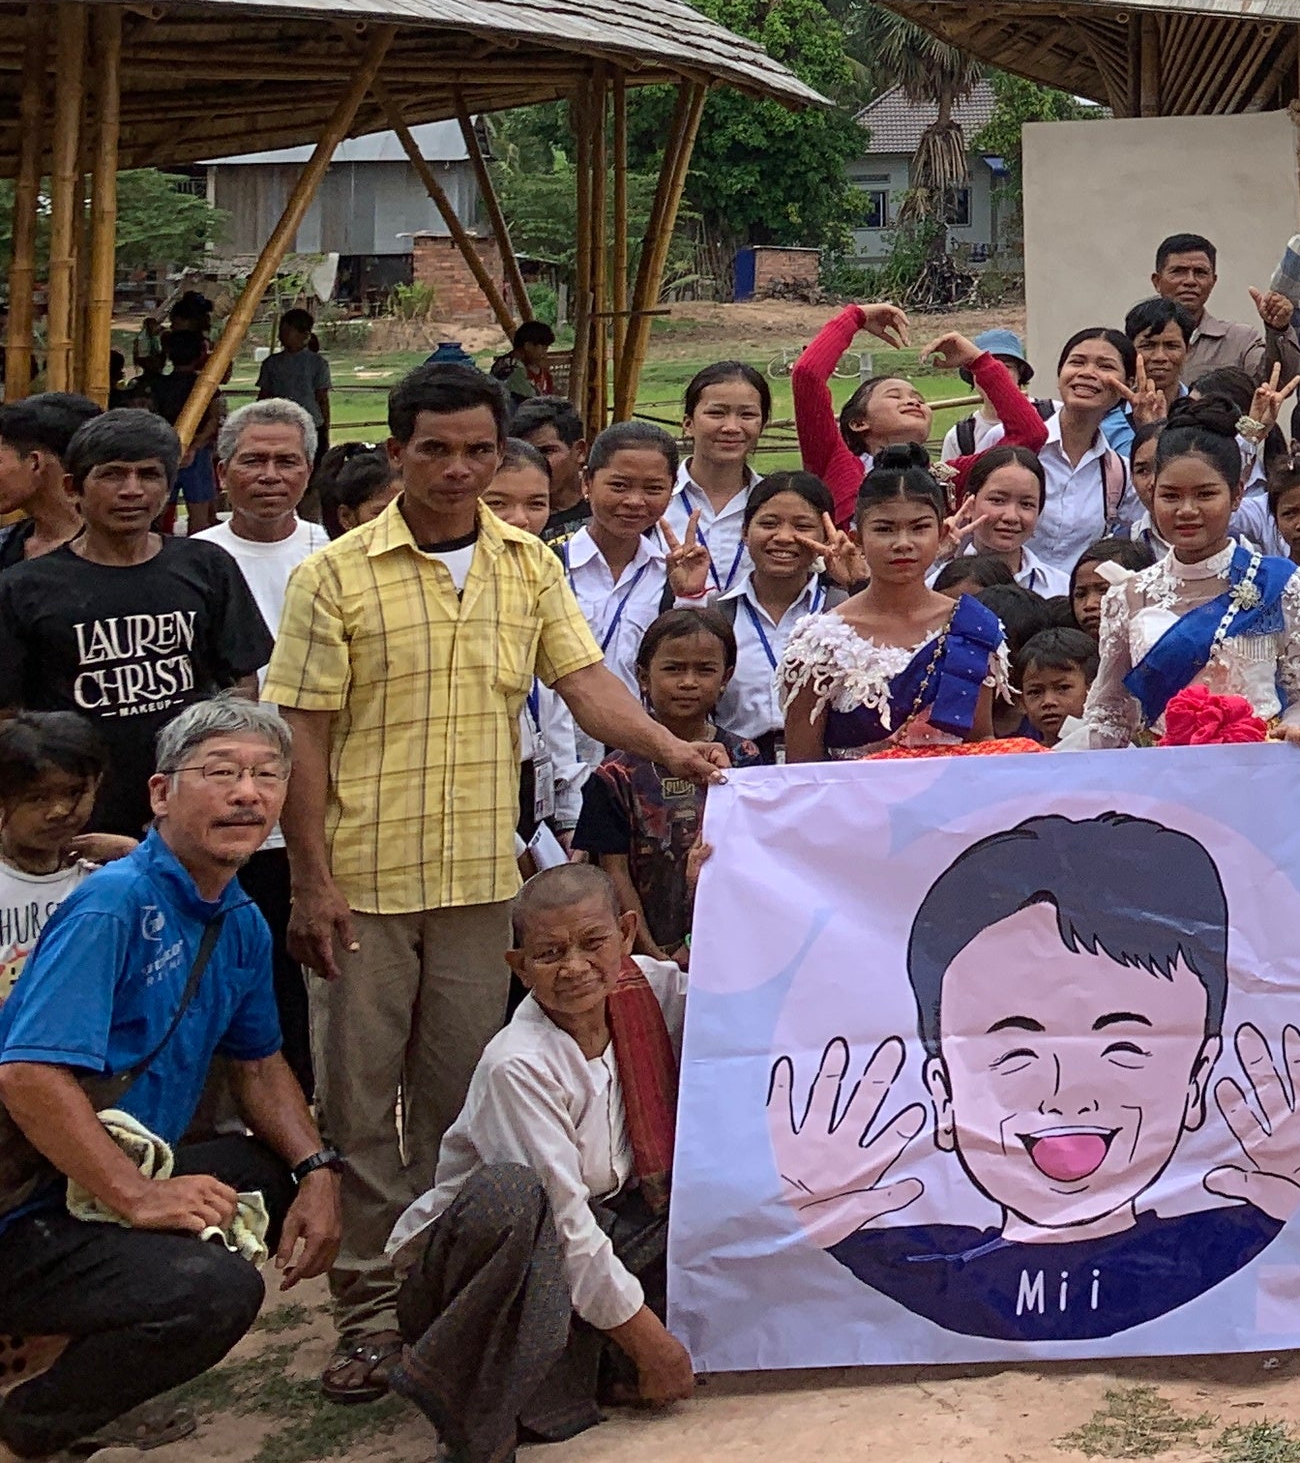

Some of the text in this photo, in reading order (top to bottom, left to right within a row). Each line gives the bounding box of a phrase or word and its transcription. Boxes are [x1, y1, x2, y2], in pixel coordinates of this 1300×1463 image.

[72, 611, 197, 666] LAUREN
[119, 700, 172, 718] MAKEUP
[1016, 1269, 1100, 1316] Mii
